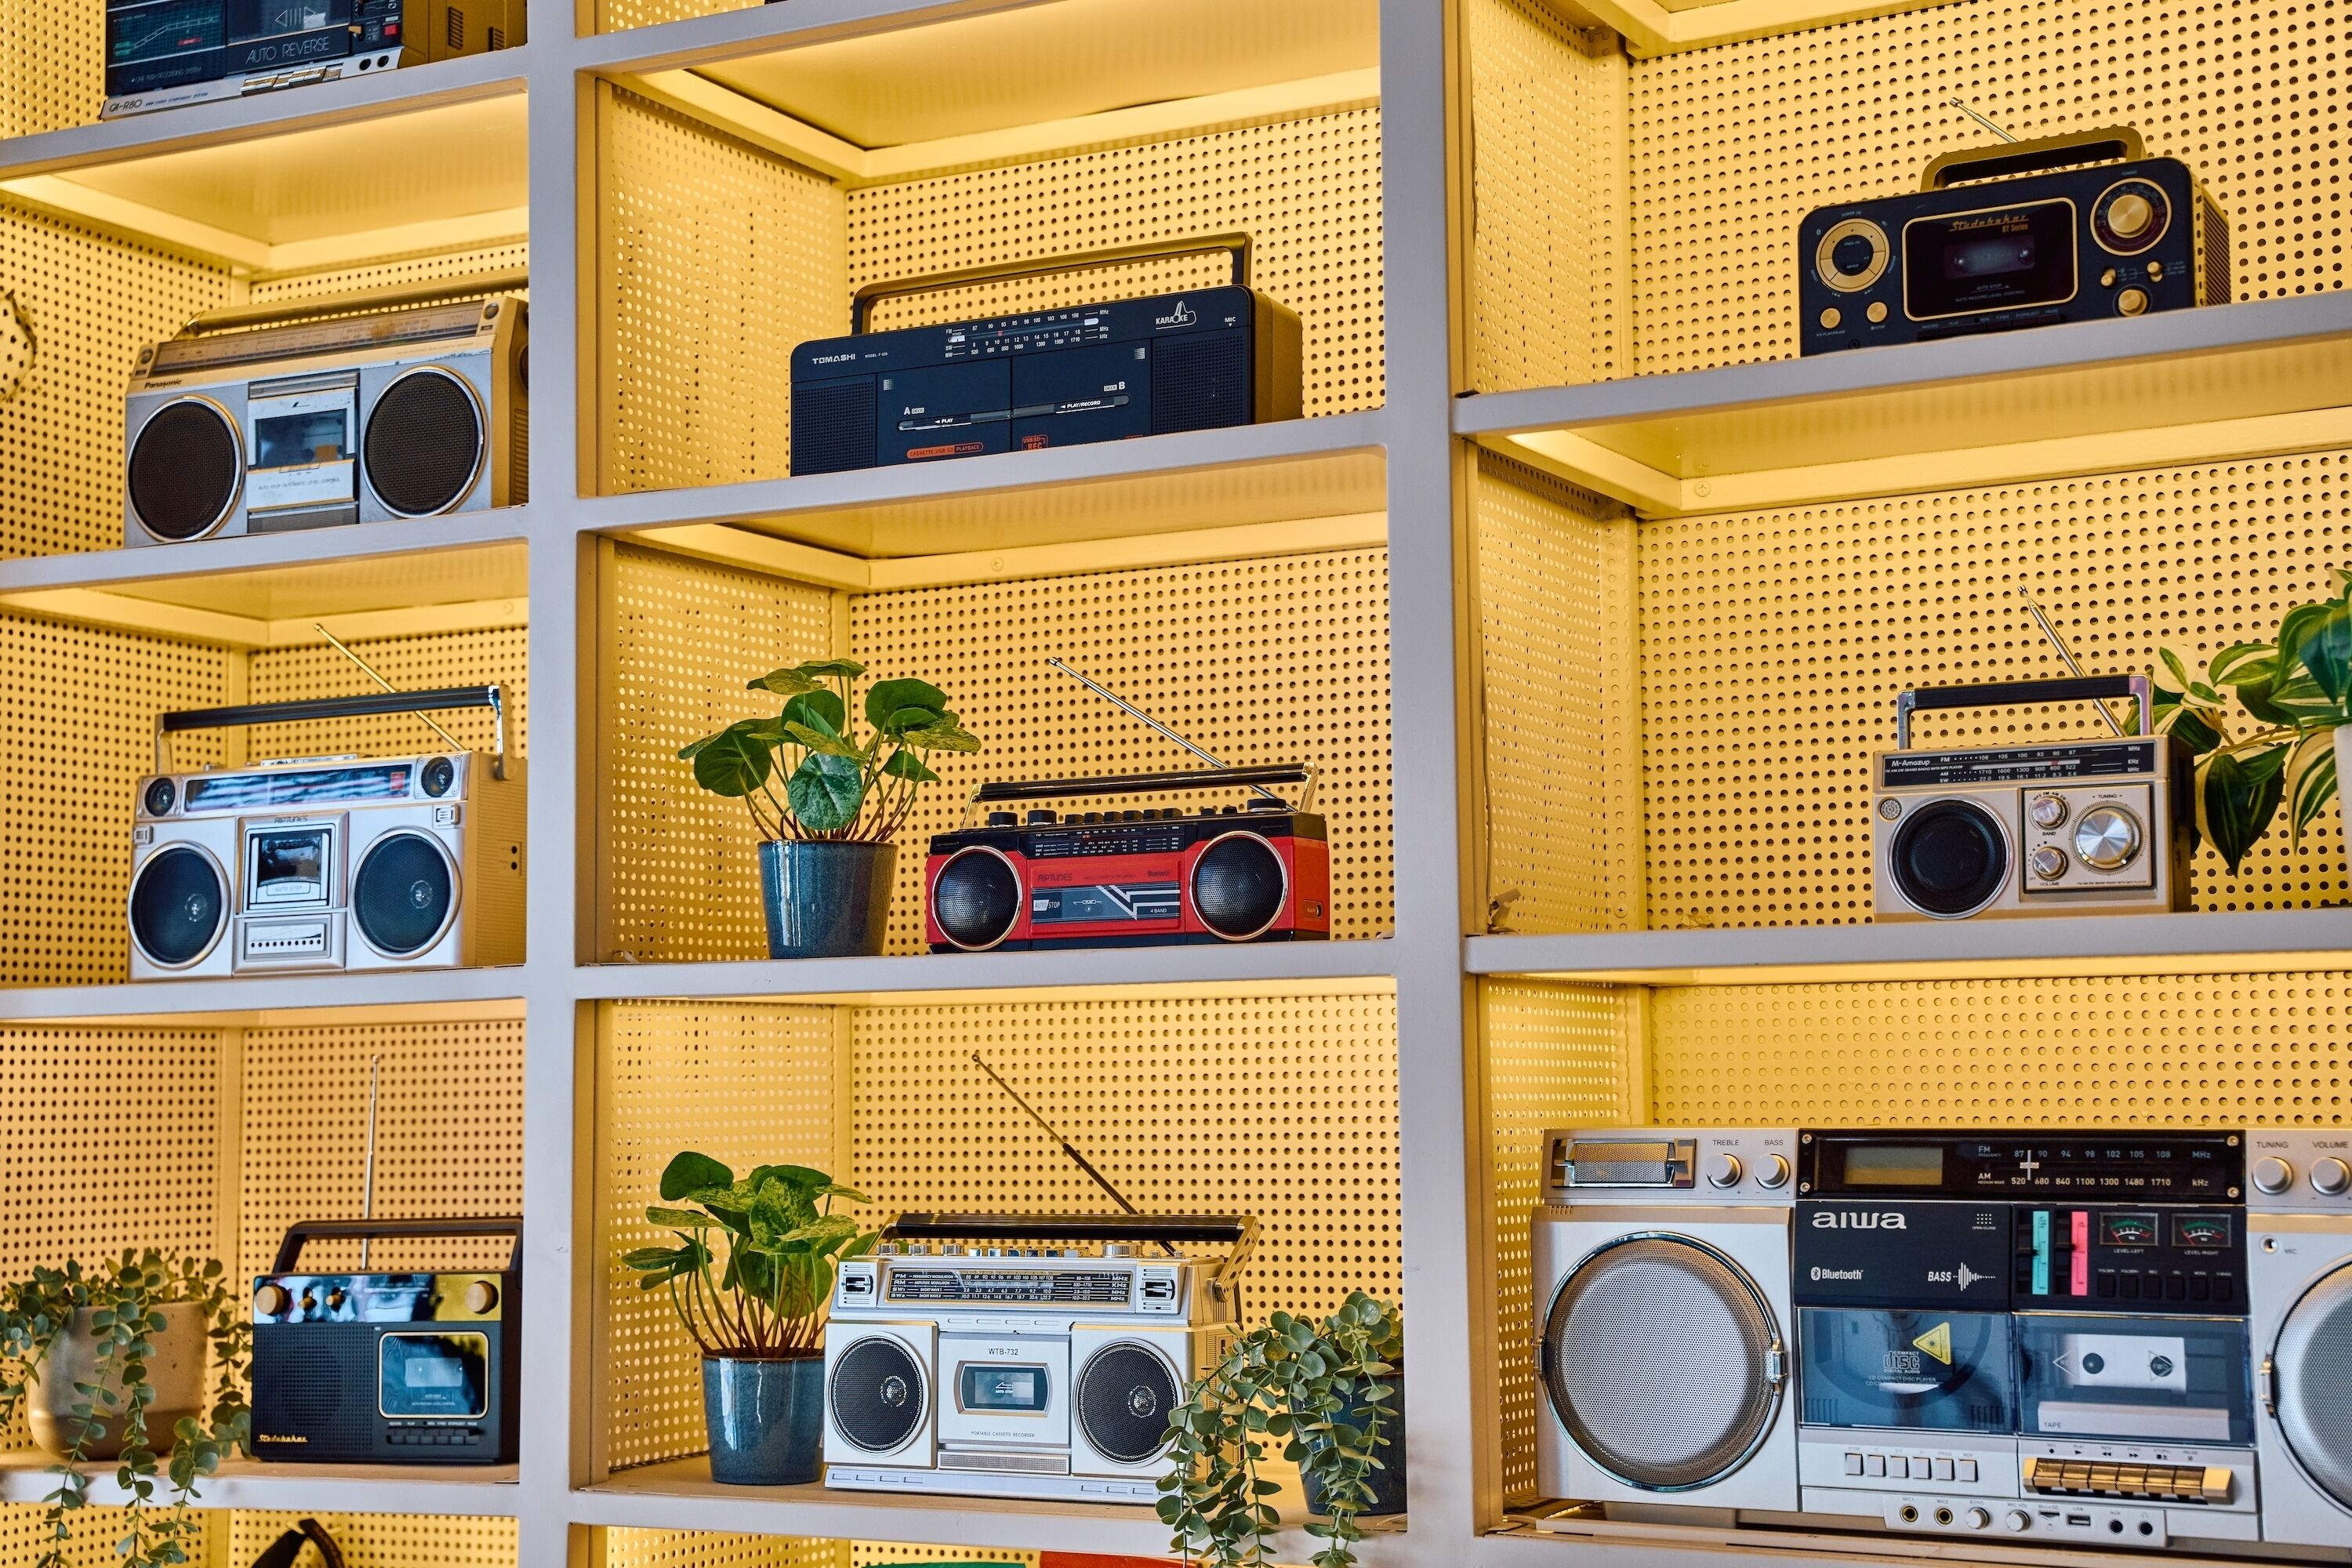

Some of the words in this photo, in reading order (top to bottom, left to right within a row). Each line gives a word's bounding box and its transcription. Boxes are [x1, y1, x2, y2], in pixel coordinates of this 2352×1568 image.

[245, 46, 278, 64] AUTO
[282, 37, 329, 58] REVERSE
[1948, 214, 2029, 231] Studebaker
[1156, 314, 1188, 325] KARAOKE
[812, 354, 856, 364] TOMASHI
[144, 379, 182, 389] Panasonic
[903, 407, 910, 416] A
[1812, 1211, 1907, 1229] aiwa
[1822, 1269, 1862, 1279] Bluetooth
[1928, 1272, 1951, 1282] BASS
[1883, 1351, 1919, 1370] disc
